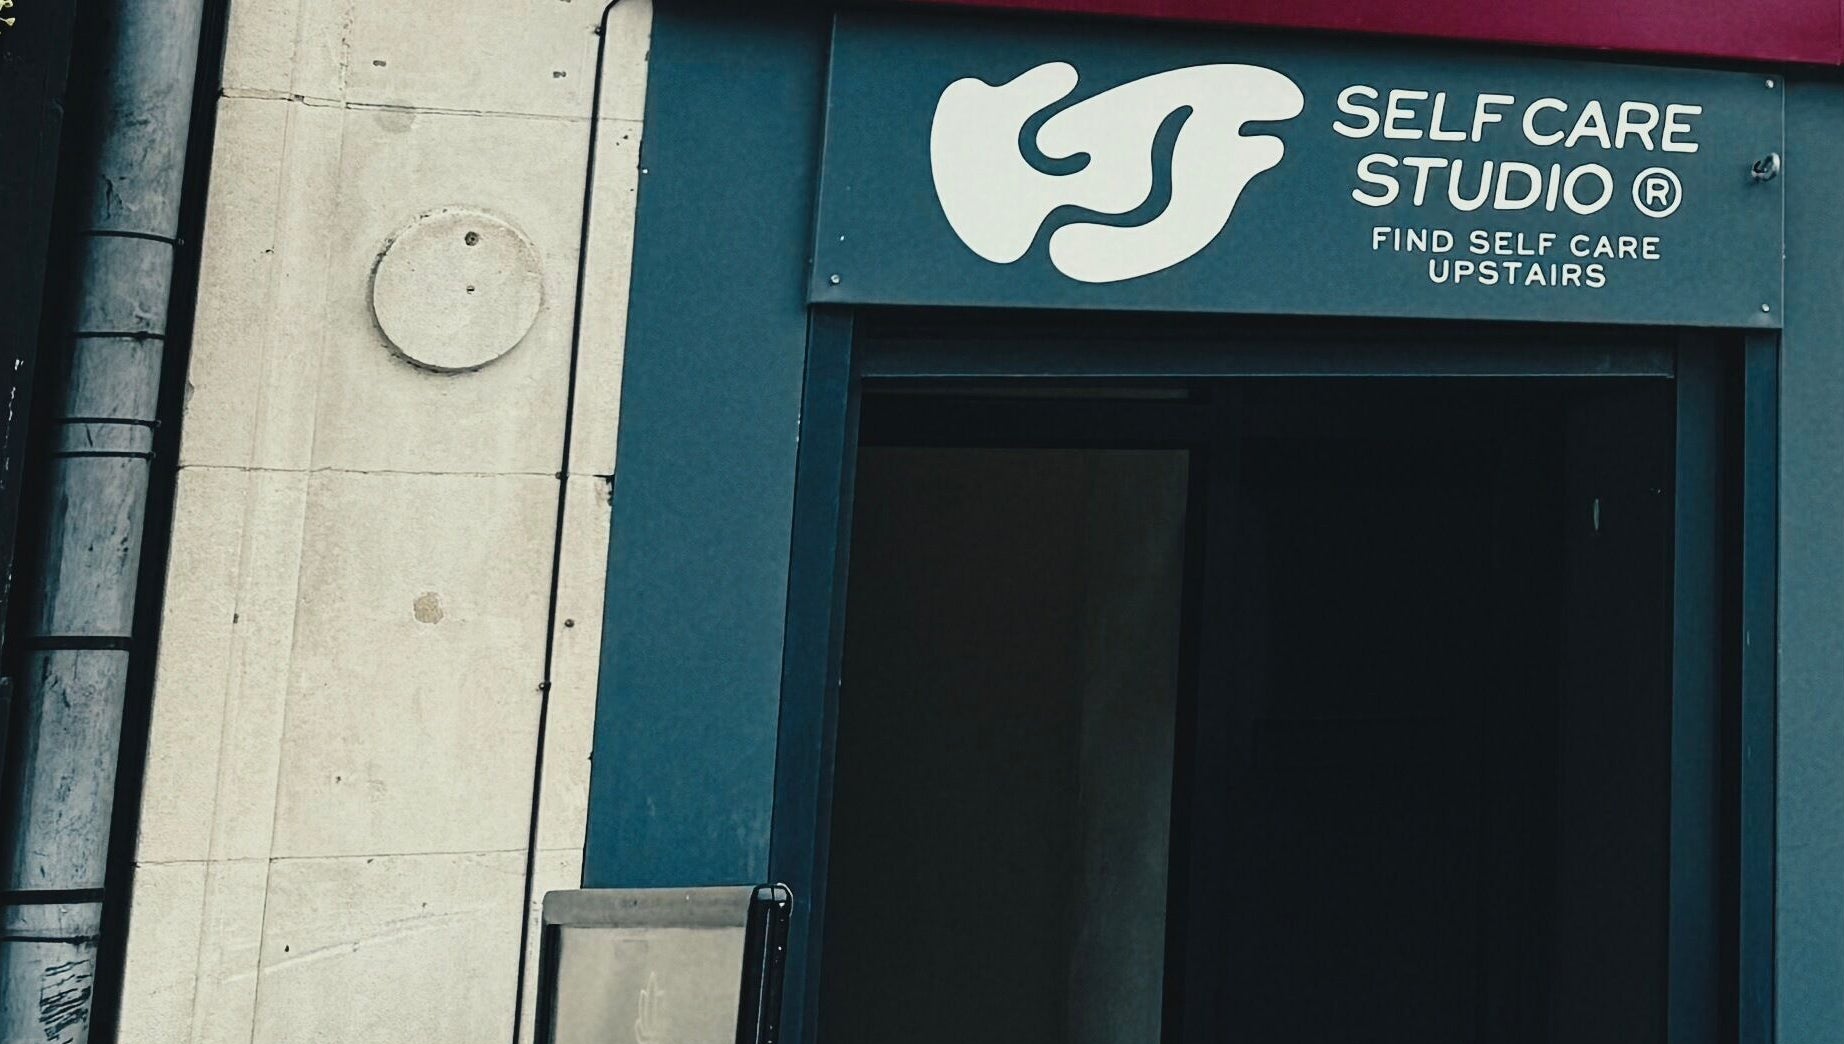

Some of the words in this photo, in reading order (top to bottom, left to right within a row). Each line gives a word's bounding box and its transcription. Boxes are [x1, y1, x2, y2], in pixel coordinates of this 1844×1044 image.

[1332, 84, 1516, 144] SELF
[1521, 97, 1703, 154] CARE
[1351, 153, 1614, 216] STUDIO
[1371, 226, 1455, 254] FIND
[1468, 230, 1557, 257] SELF
[1568, 235, 1662, 261] CARE
[1427, 258, 1608, 289] UPSTAIRS
